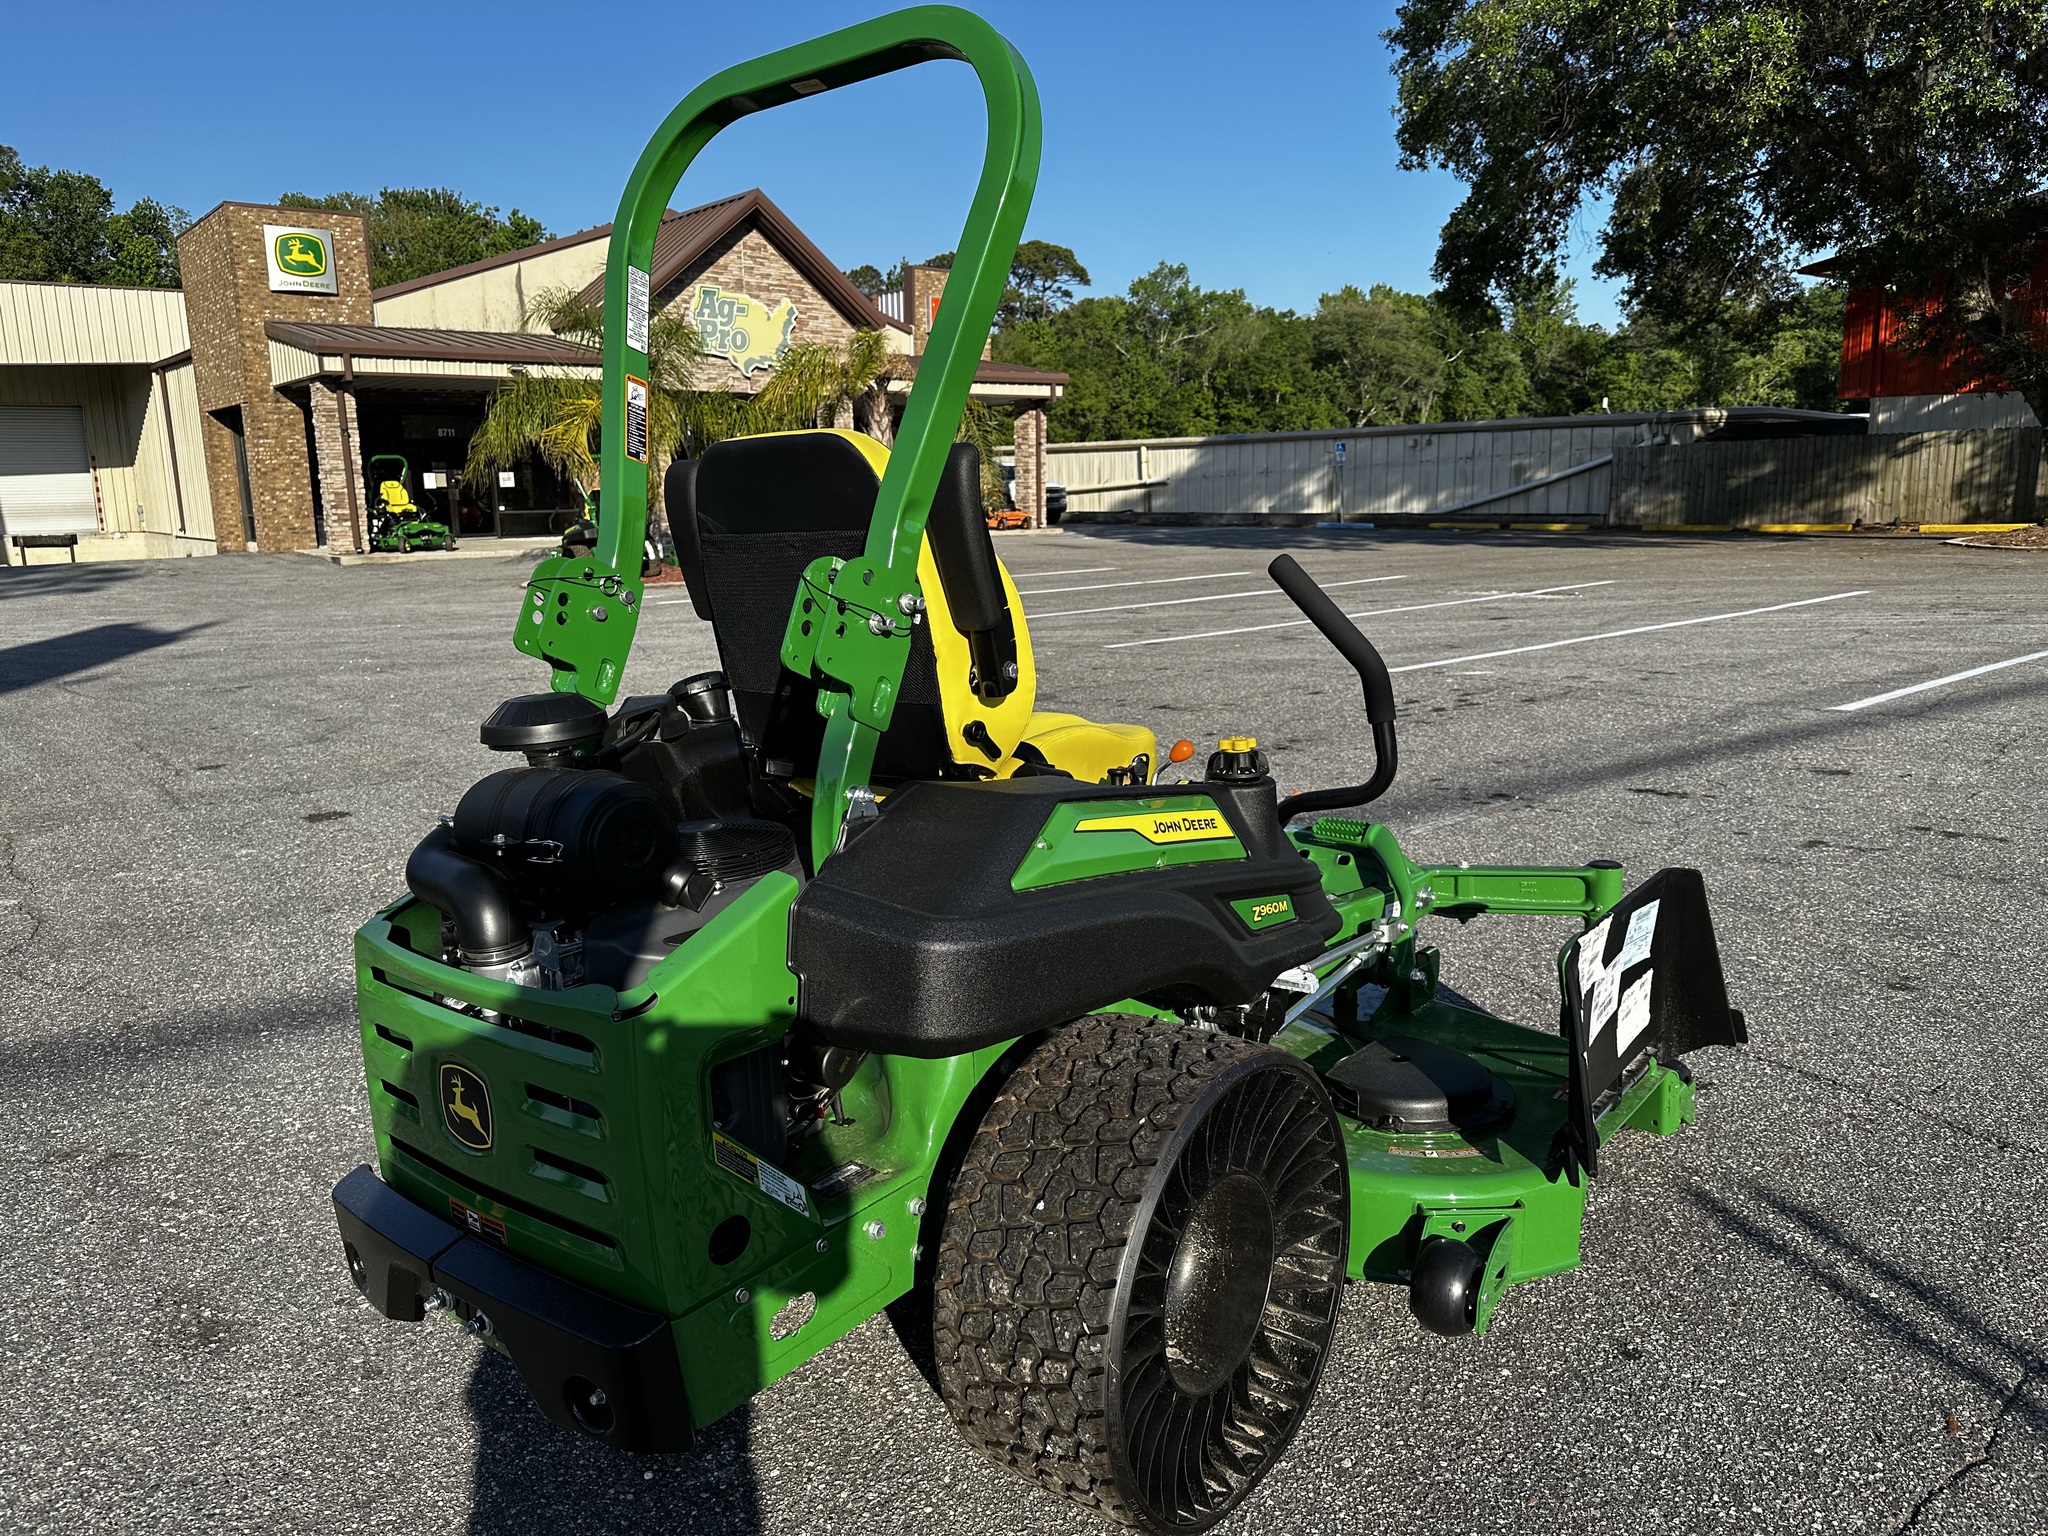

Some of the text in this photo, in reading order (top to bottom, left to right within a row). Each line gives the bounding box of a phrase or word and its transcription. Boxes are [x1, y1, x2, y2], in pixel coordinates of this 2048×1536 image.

[303, 281, 331, 289] DEERE
[697, 289, 747, 327] Ag-
[700, 319, 748, 351] Pro
[437, 428, 455, 437] 8711
[1153, 818, 1218, 834] JOHN DEERE
[1252, 900, 1288, 922] Z960M
